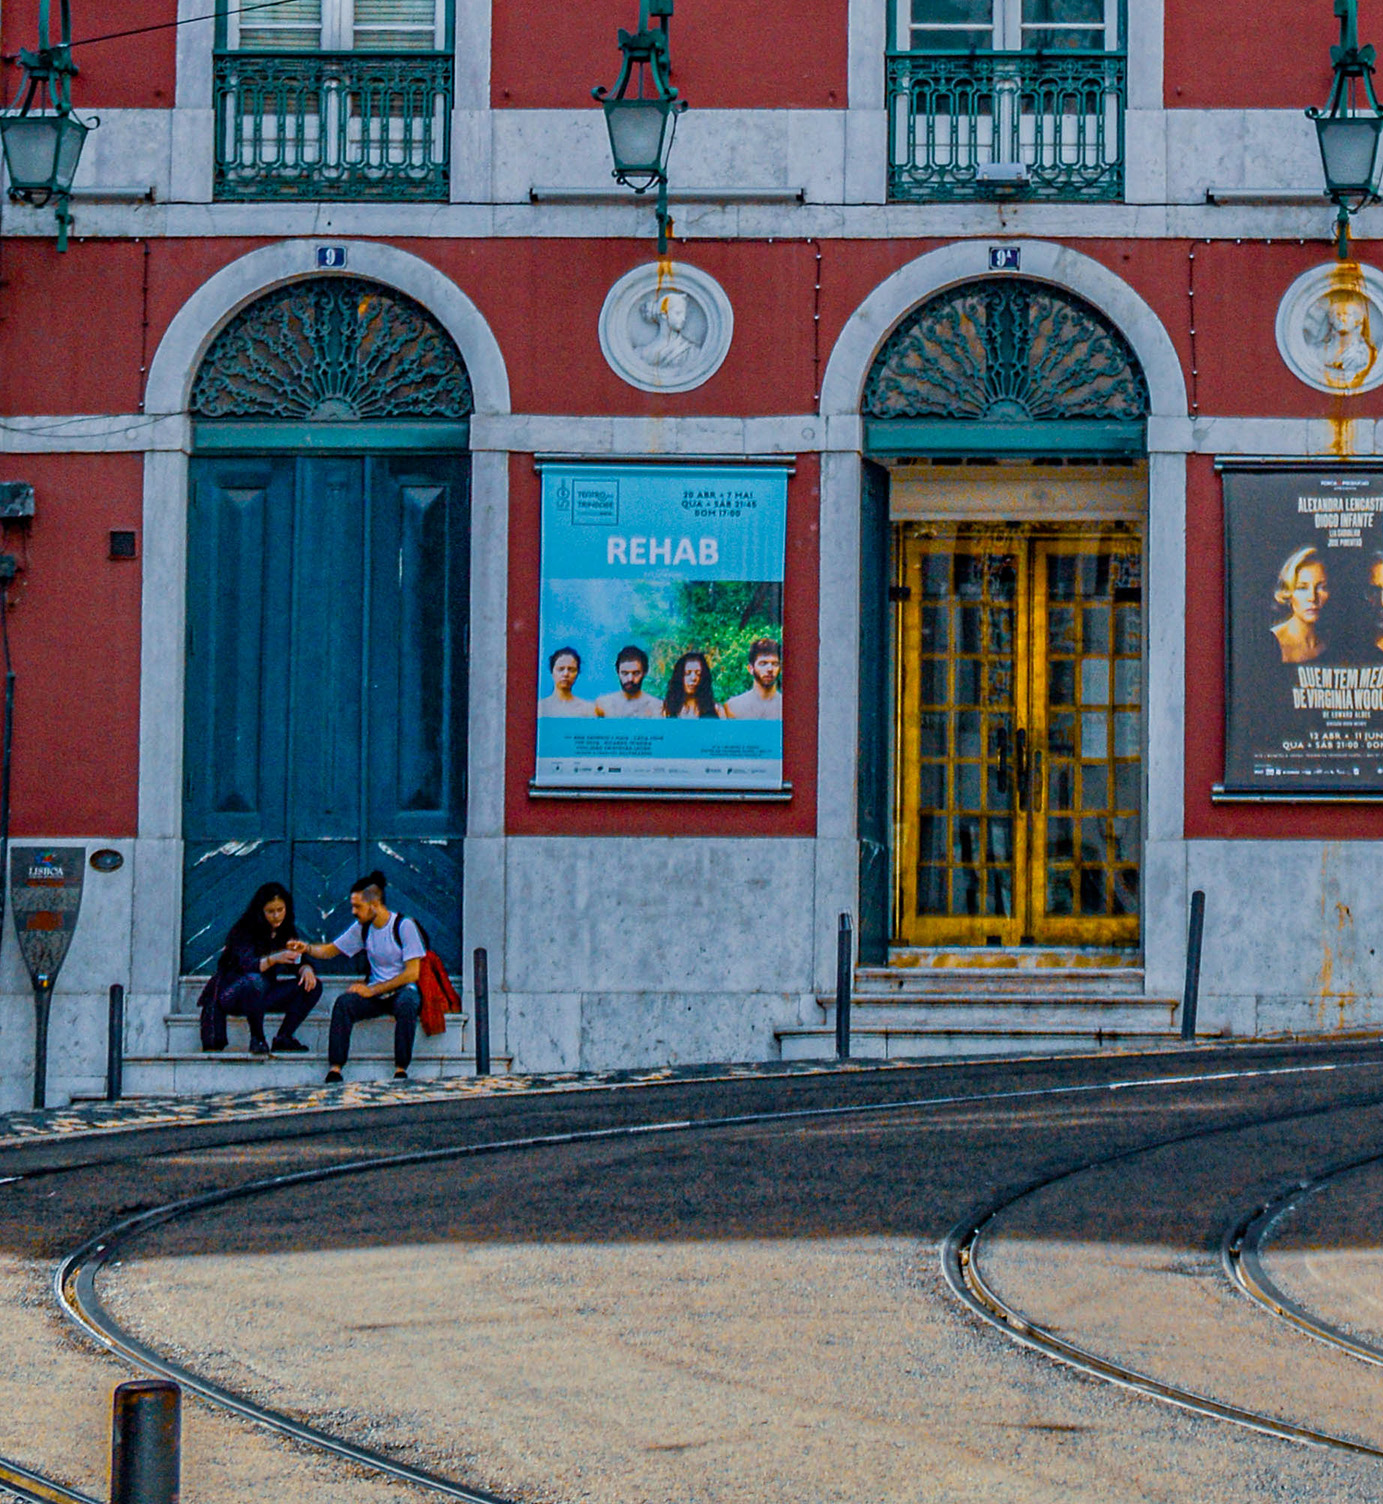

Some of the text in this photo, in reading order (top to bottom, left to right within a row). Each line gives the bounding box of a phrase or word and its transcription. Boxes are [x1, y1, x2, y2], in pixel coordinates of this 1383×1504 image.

[325, 248, 336, 266] 9
[1298, 497, 1383, 513] ALEXANDRA LENCASTR
[1340, 512, 1375, 528] INFANTE
[607, 536, 719, 565] REHAB
[1298, 666, 1333, 688] QUEM
[1333, 668, 1359, 689] TEM
[1293, 688, 1307, 709] DE
[1307, 688, 1354, 710] VIRGINIA
[1322, 732, 1342, 740] ABR
[1364, 732, 1383, 741] JUN
[1282, 741, 1304, 751] QUA
